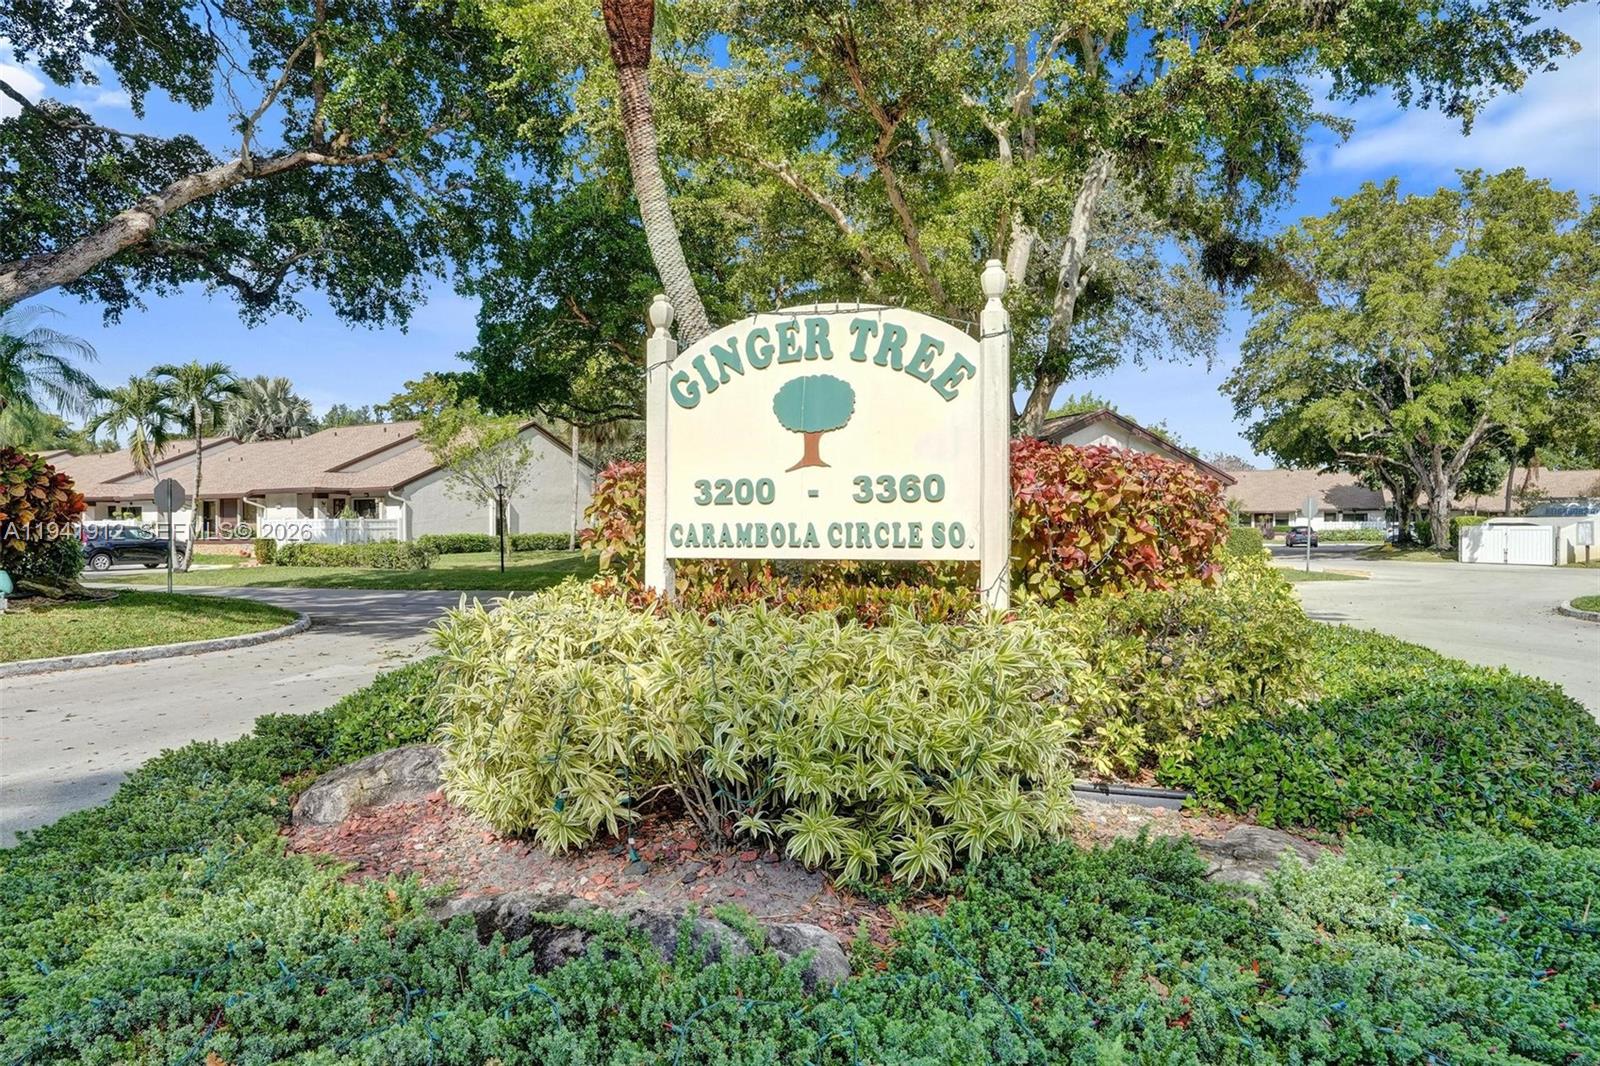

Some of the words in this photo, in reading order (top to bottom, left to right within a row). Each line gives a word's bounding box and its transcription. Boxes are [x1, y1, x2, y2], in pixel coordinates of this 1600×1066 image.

[669, 317, 834, 410] GINGER
[849, 318, 977, 402] TREE
[693, 477, 776, 506] 3200
[807, 489, 819, 498] -
[851, 473, 946, 504] 3360
[669, 521, 821, 549] CARAMBOLA
[827, 521, 924, 549] CIRCLE
[930, 521, 976, 549] SO.
